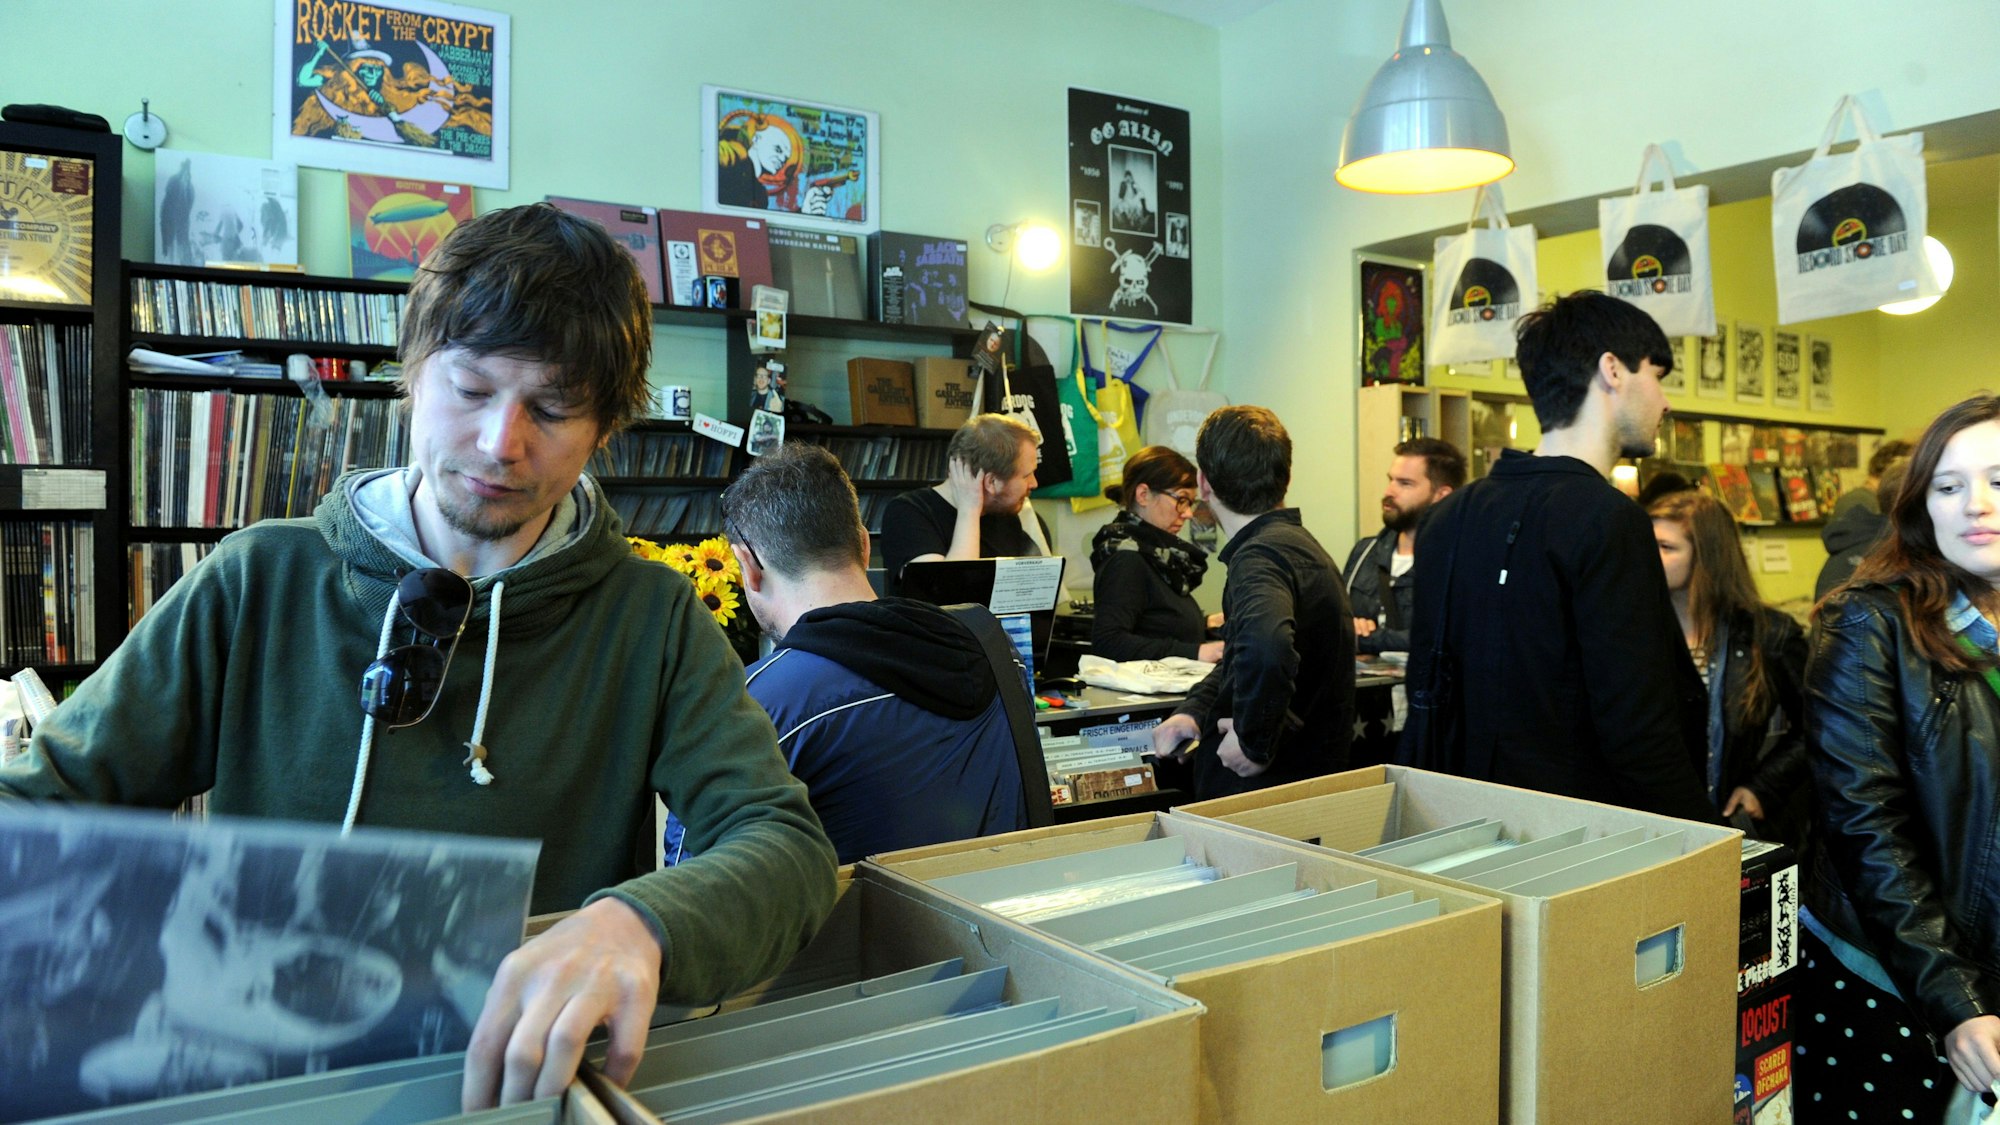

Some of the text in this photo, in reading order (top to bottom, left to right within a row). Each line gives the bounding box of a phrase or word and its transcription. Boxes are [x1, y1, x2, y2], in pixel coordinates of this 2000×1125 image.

[296, 0, 492, 50] ROCKET FROM CRYPT
[391, 26, 416, 41] THE
[438, 44, 492, 65] JABBERJAW
[448, 63, 490, 77] MONDAY
[440, 130, 453, 140] THE
[1118, 119, 1173, 157] ALLIN
[0, 181, 44, 211] UN
[13, 222, 56, 233] COMPANY
[795, 231, 820, 240] YOUTH
[813, 242, 841, 252] NATION
[923, 241, 957, 254] BLACK
[915, 252, 964, 267] SABBATH
[945, 382, 960, 392] THE
[936, 390, 974, 400] GASLIGHT
[1082, 720, 1160, 738] FRISCH EINGETROFFEN
[1741, 994, 1791, 1048] LOCUST
[1759, 1049, 1787, 1076] SCARED
[1756, 1065, 1788, 1096] OFCHAKA
